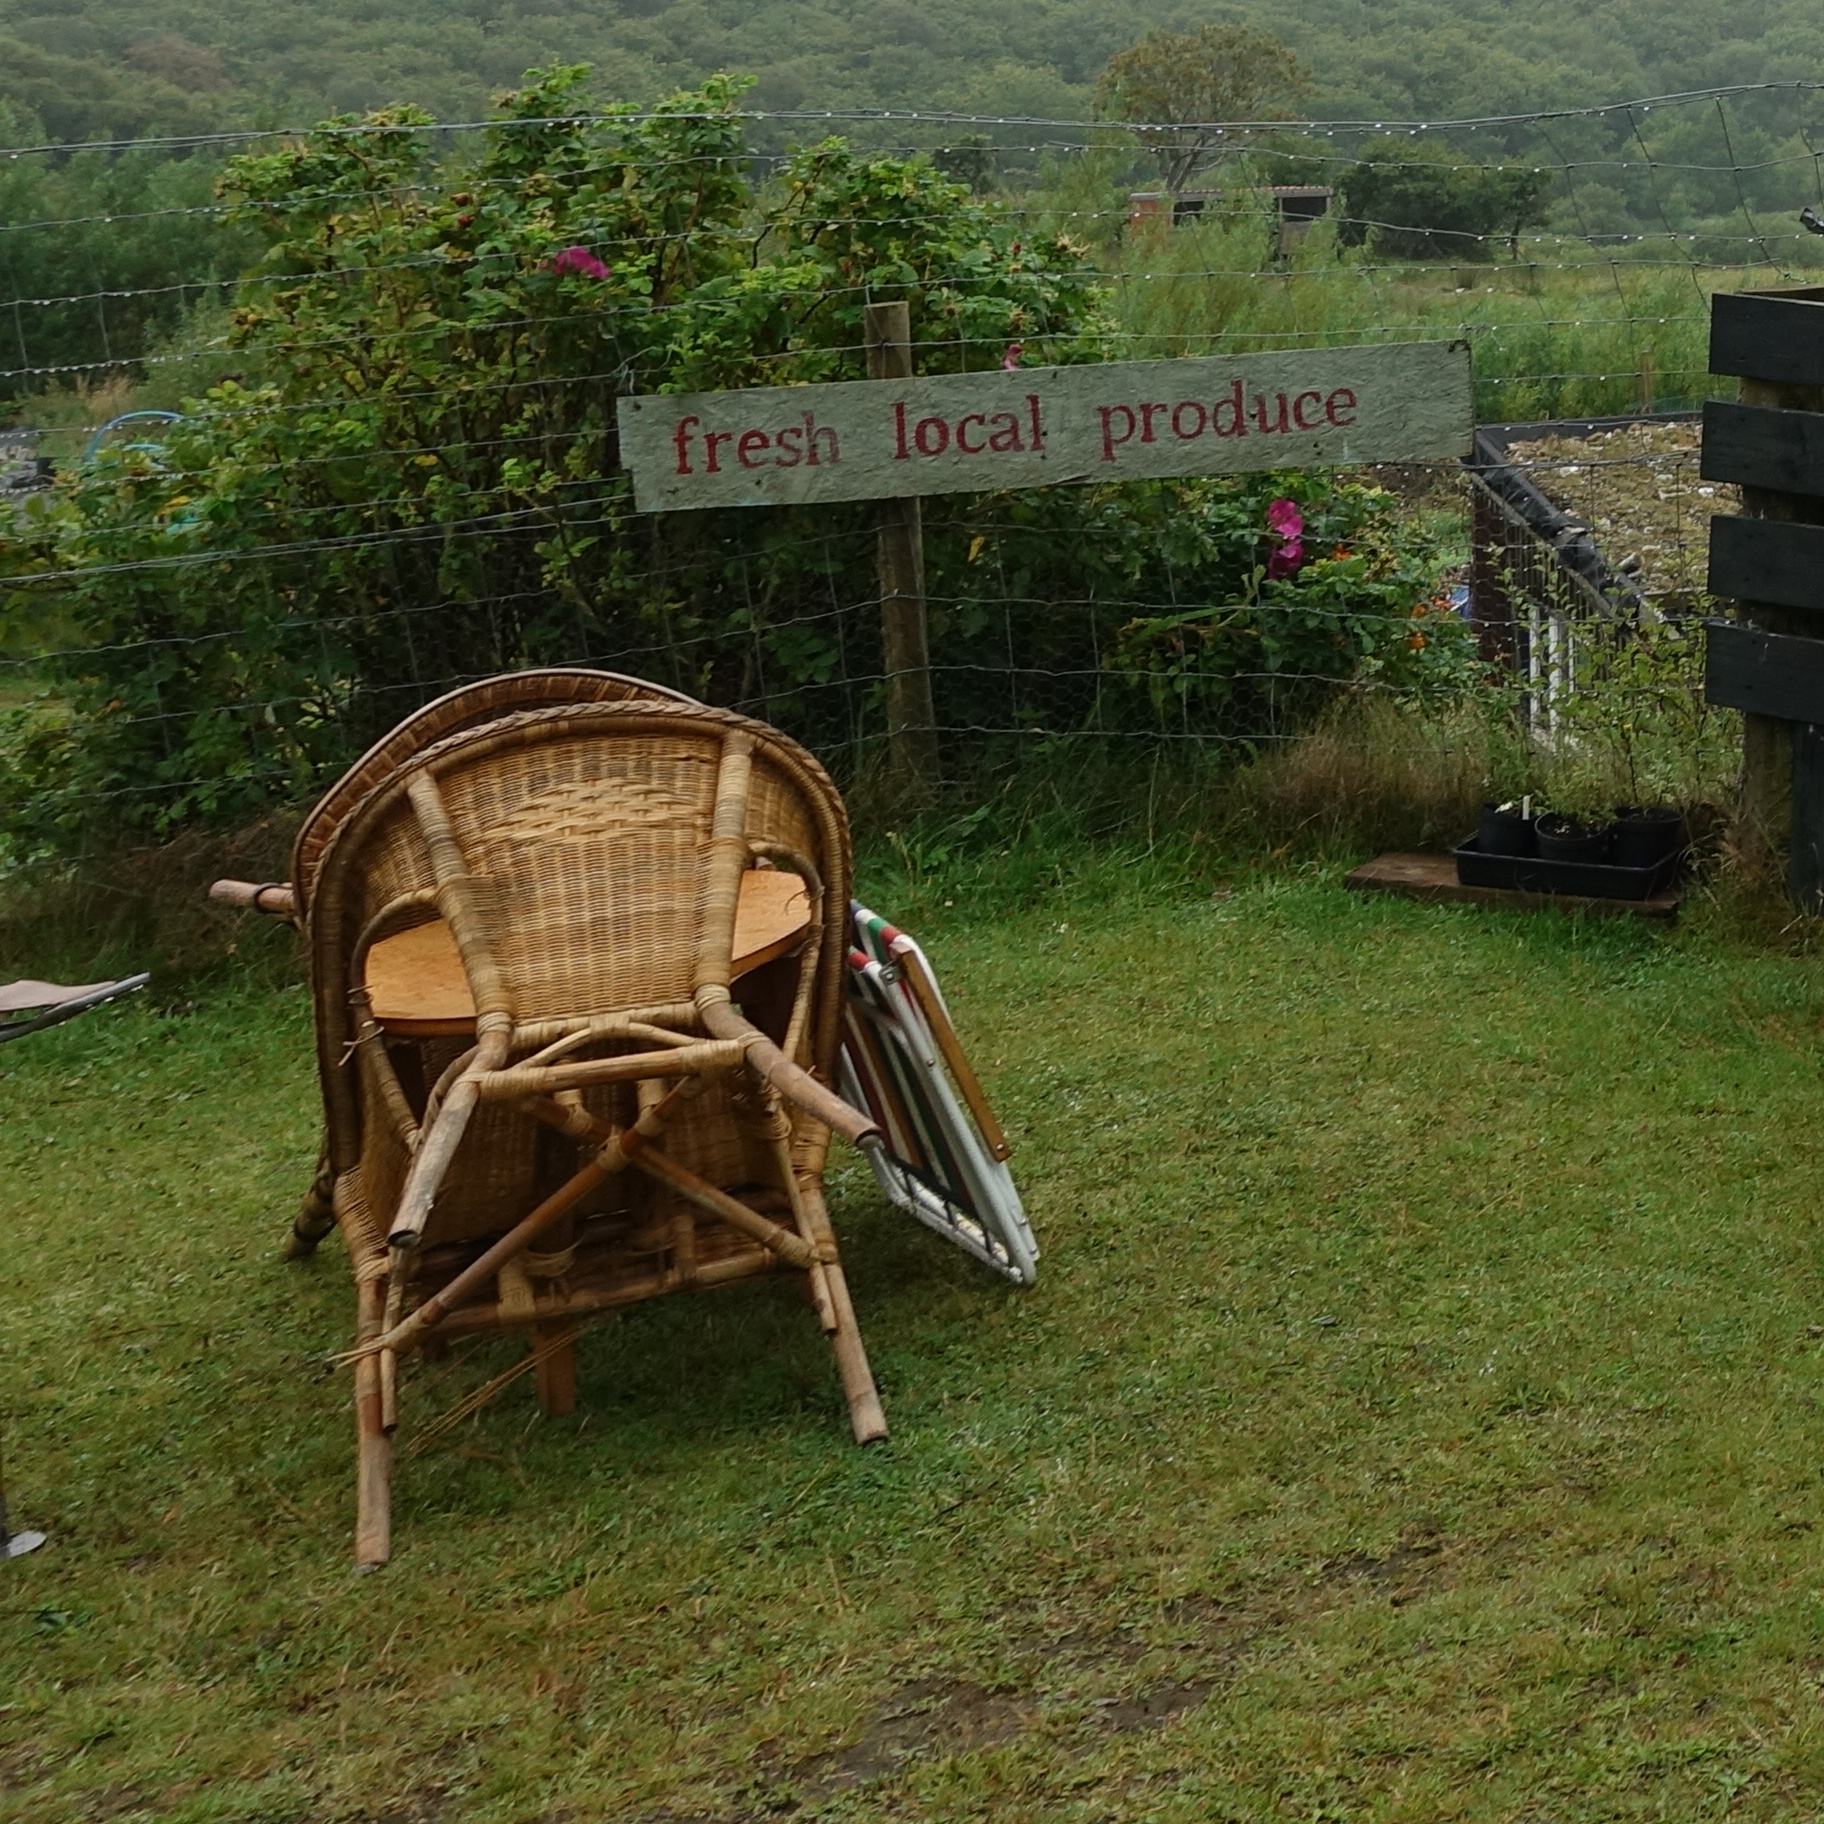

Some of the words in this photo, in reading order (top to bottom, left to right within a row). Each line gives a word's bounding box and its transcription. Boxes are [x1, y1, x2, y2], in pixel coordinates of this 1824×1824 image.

[673, 414, 840, 476] fresh
[893, 393, 1044, 461] local
[1099, 380, 1358, 461] produce
